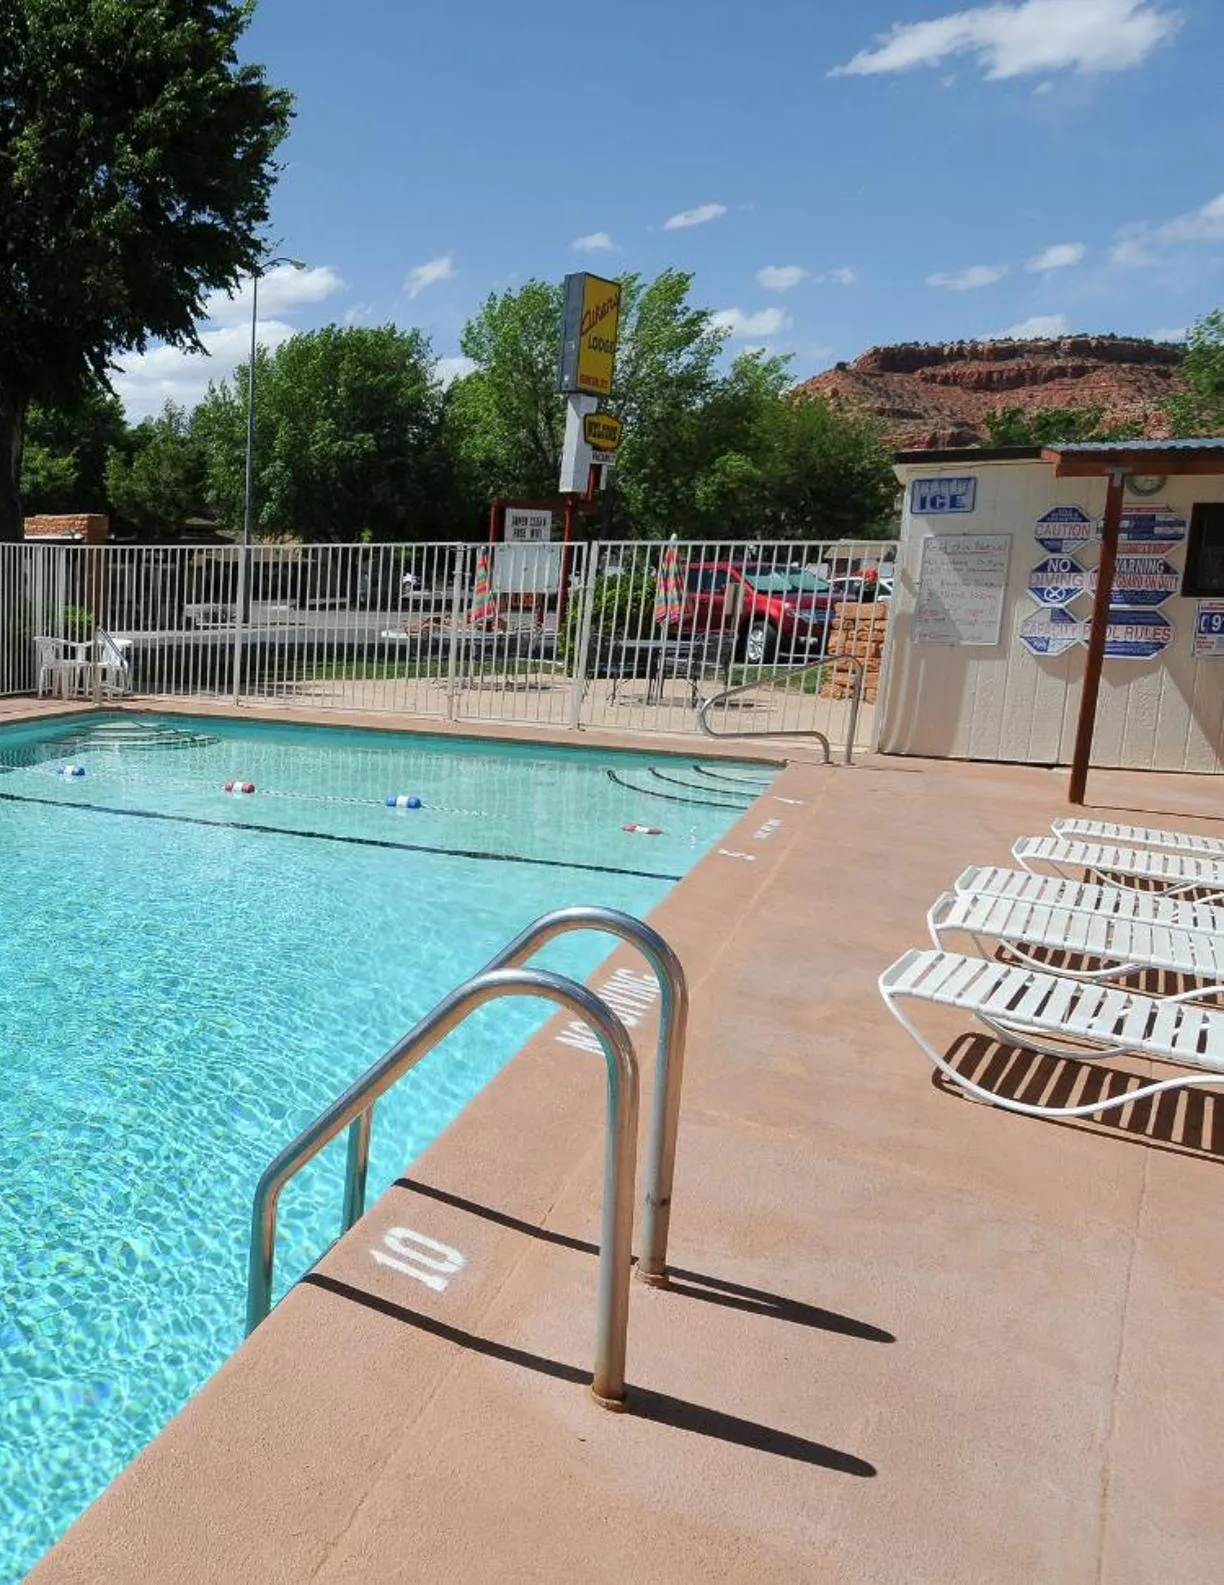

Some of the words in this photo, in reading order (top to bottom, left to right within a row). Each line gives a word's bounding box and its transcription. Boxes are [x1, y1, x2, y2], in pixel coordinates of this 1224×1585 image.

[920, 495, 965, 510] ICE
[1035, 523, 1090, 538] CAUTION
[1048, 559, 1071, 573] NO
[1029, 574, 1084, 588] DIVING
[1125, 627, 1171, 641] RULES
[369, 1226, 466, 1292] 10
